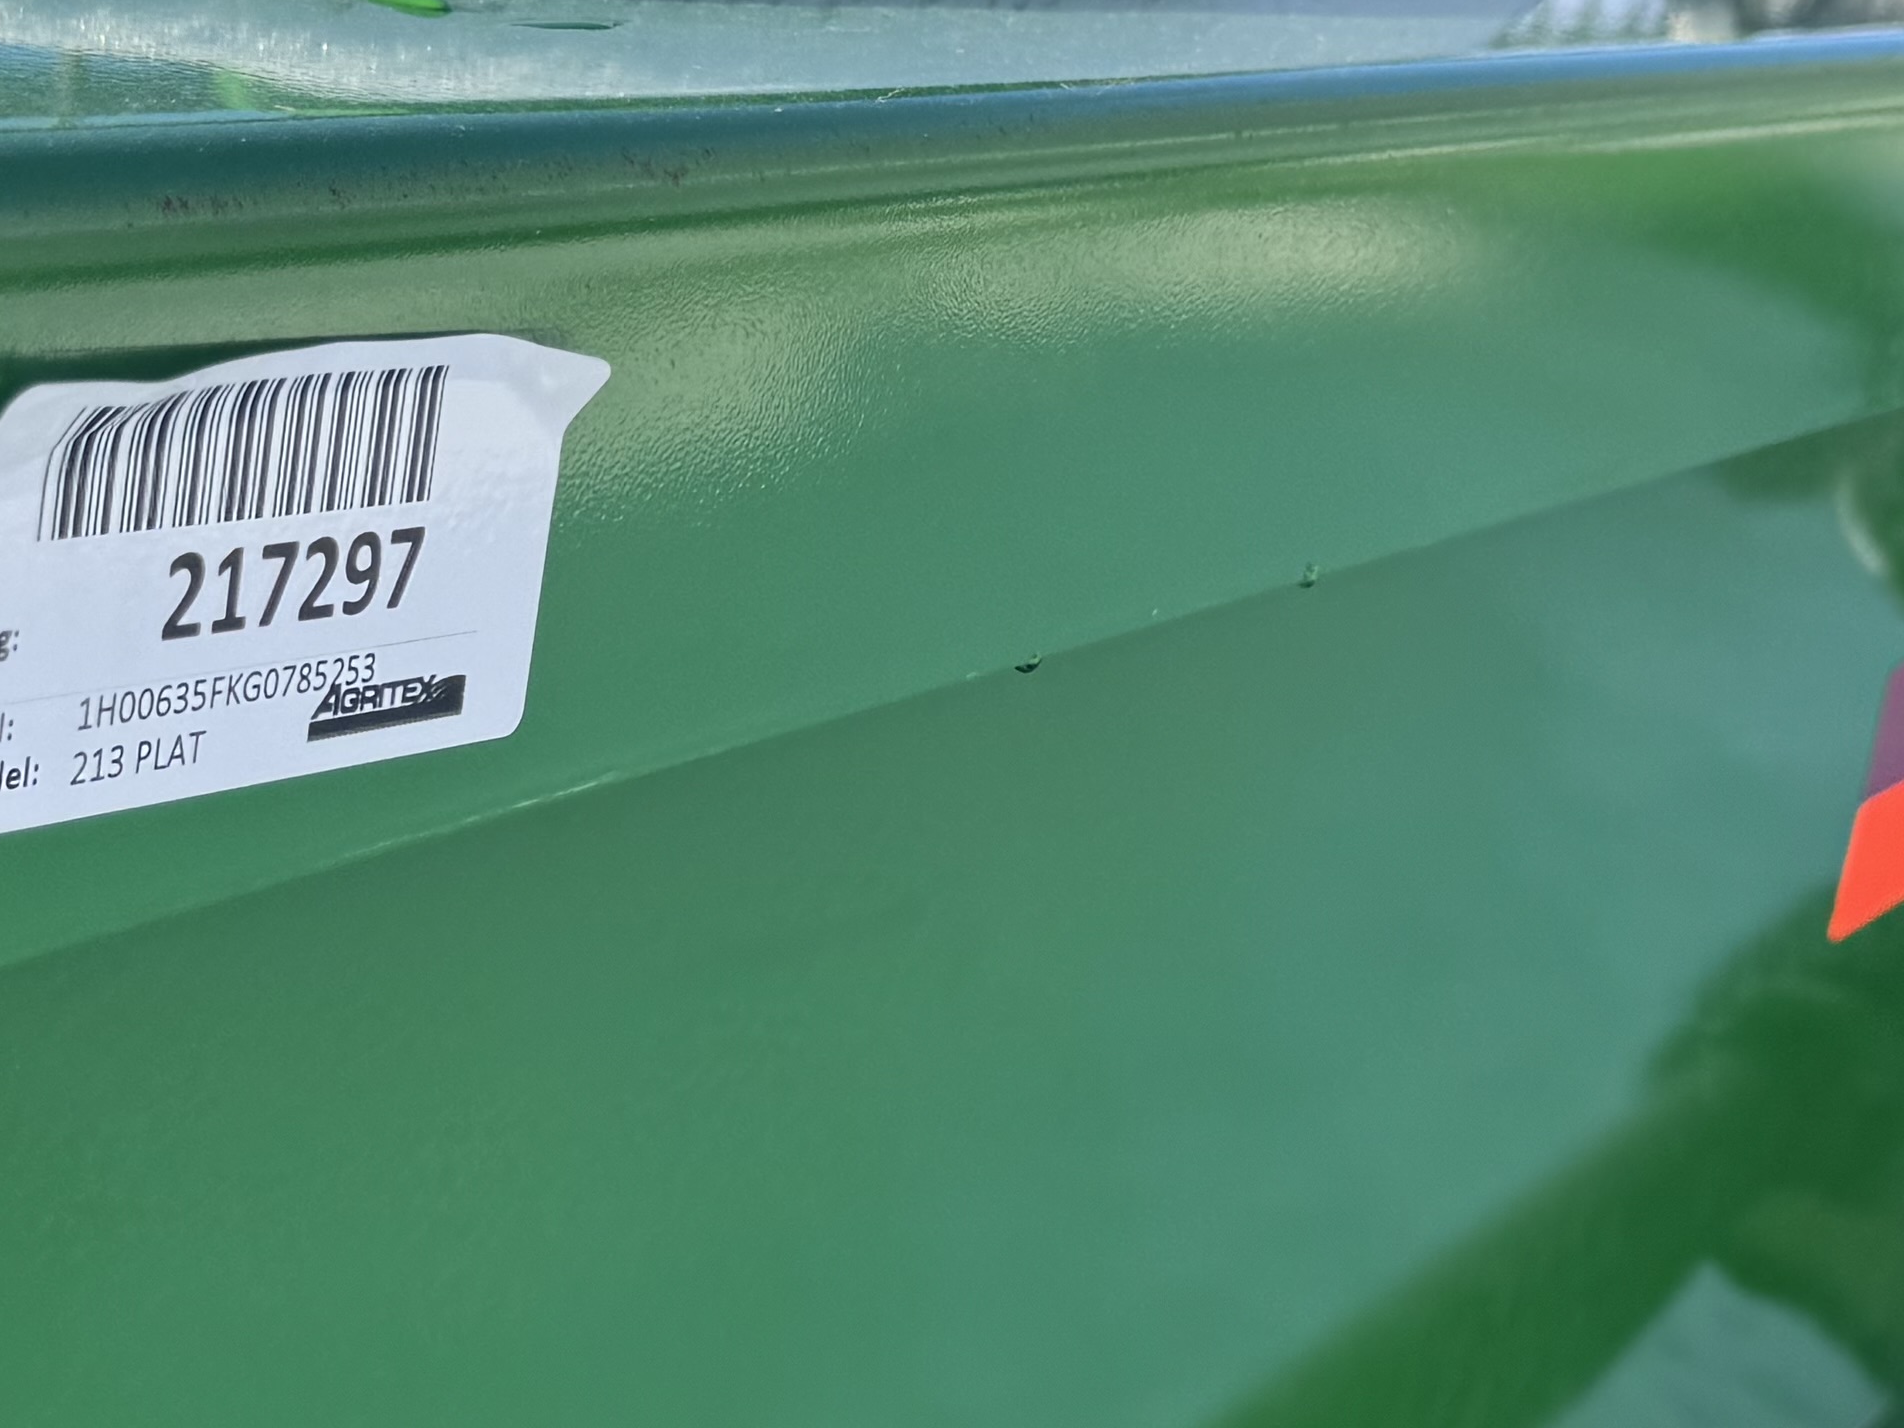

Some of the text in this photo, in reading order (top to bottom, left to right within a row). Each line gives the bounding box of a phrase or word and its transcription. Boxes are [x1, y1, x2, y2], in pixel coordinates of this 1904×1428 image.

[161, 526, 427, 642] 217297
[78, 653, 376, 732] 1H00635FKG0785253
[310, 674, 438, 720] AGRITEX
[70, 745, 125, 786] 213
[135, 731, 207, 774] PLAT
